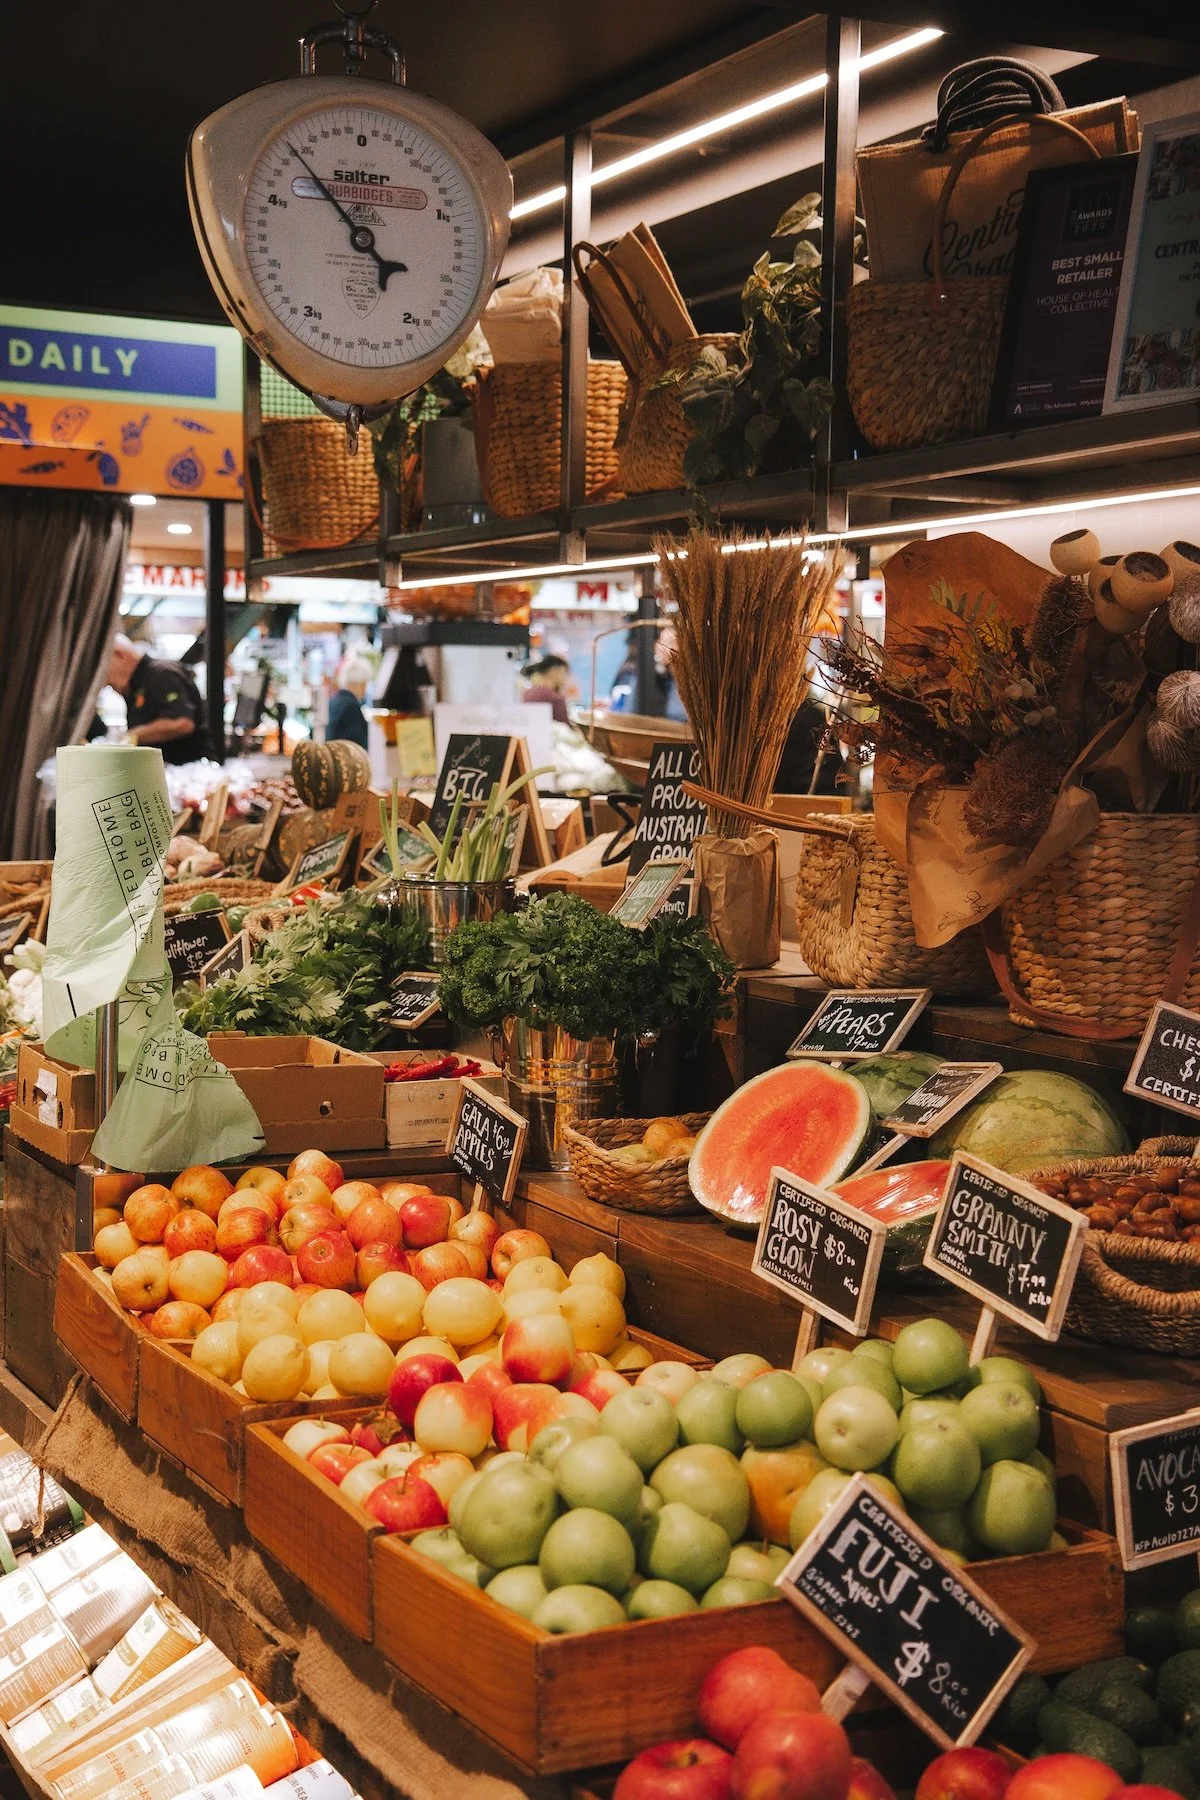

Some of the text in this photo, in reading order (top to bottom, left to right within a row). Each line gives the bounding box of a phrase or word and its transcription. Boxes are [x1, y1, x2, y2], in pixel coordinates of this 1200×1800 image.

[357, 135, 367, 146] 0
[334, 170, 390, 185] salter
[268, 194, 287, 208] 4kg
[328, 184, 393, 202] BURBIDGES
[436, 209, 450, 223] 1kg
[1077, 208, 1112, 220] AWARDS
[1052, 251, 1123, 270] BEST SMALL
[1154, 240, 1200, 258] CENTR
[1056, 268, 1114, 284] RETAILER
[1036, 285, 1120, 305] HOUSE OF HEALT
[1050, 298, 1110, 314] COLLECTIVE
[304, 306, 322, 320] 3kg
[403, 312, 420, 326] 2kg
[8, 337, 139, 377] DAILY
[651, 750, 702, 779] ALL O
[651, 784, 708, 810] PRO
[148, 816, 167, 860] COMPOST
[635, 814, 709, 843] AUSTRALI
[120, 796, 160, 897] STABLE BAG
[99, 802, 150, 940] RTIFIED HOME
[165, 936, 208, 959] uliflower
[843, 996, 875, 1004] CERTIFIED
[826, 1008, 894, 1037] PEARS
[1160, 1028, 1200, 1057] CHES
[1142, 1077, 1200, 1108] CERTIFI
[462, 1103, 490, 1141] GALA
[453, 1124, 495, 1171] APPLES
[962, 1170, 1049, 1222] CERTIFIED ORGANIC
[771, 1199, 823, 1250] ROSY
[779, 1184, 870, 1244] CERTIFIED ORGANIC
[952, 1189, 1047, 1264] GRANNY
[767, 1233, 818, 1279] GLOW
[824, 1233, 856, 1266] $8.00
[948, 1220, 1010, 1268] SMITH
[1007, 1263, 1046, 1295] $7.99
[1136, 1446, 1200, 1490] AVOCA
[826, 1518, 940, 1630] FUJI
[859, 1497, 1000, 1636] CERTIFIED ORGANIC
